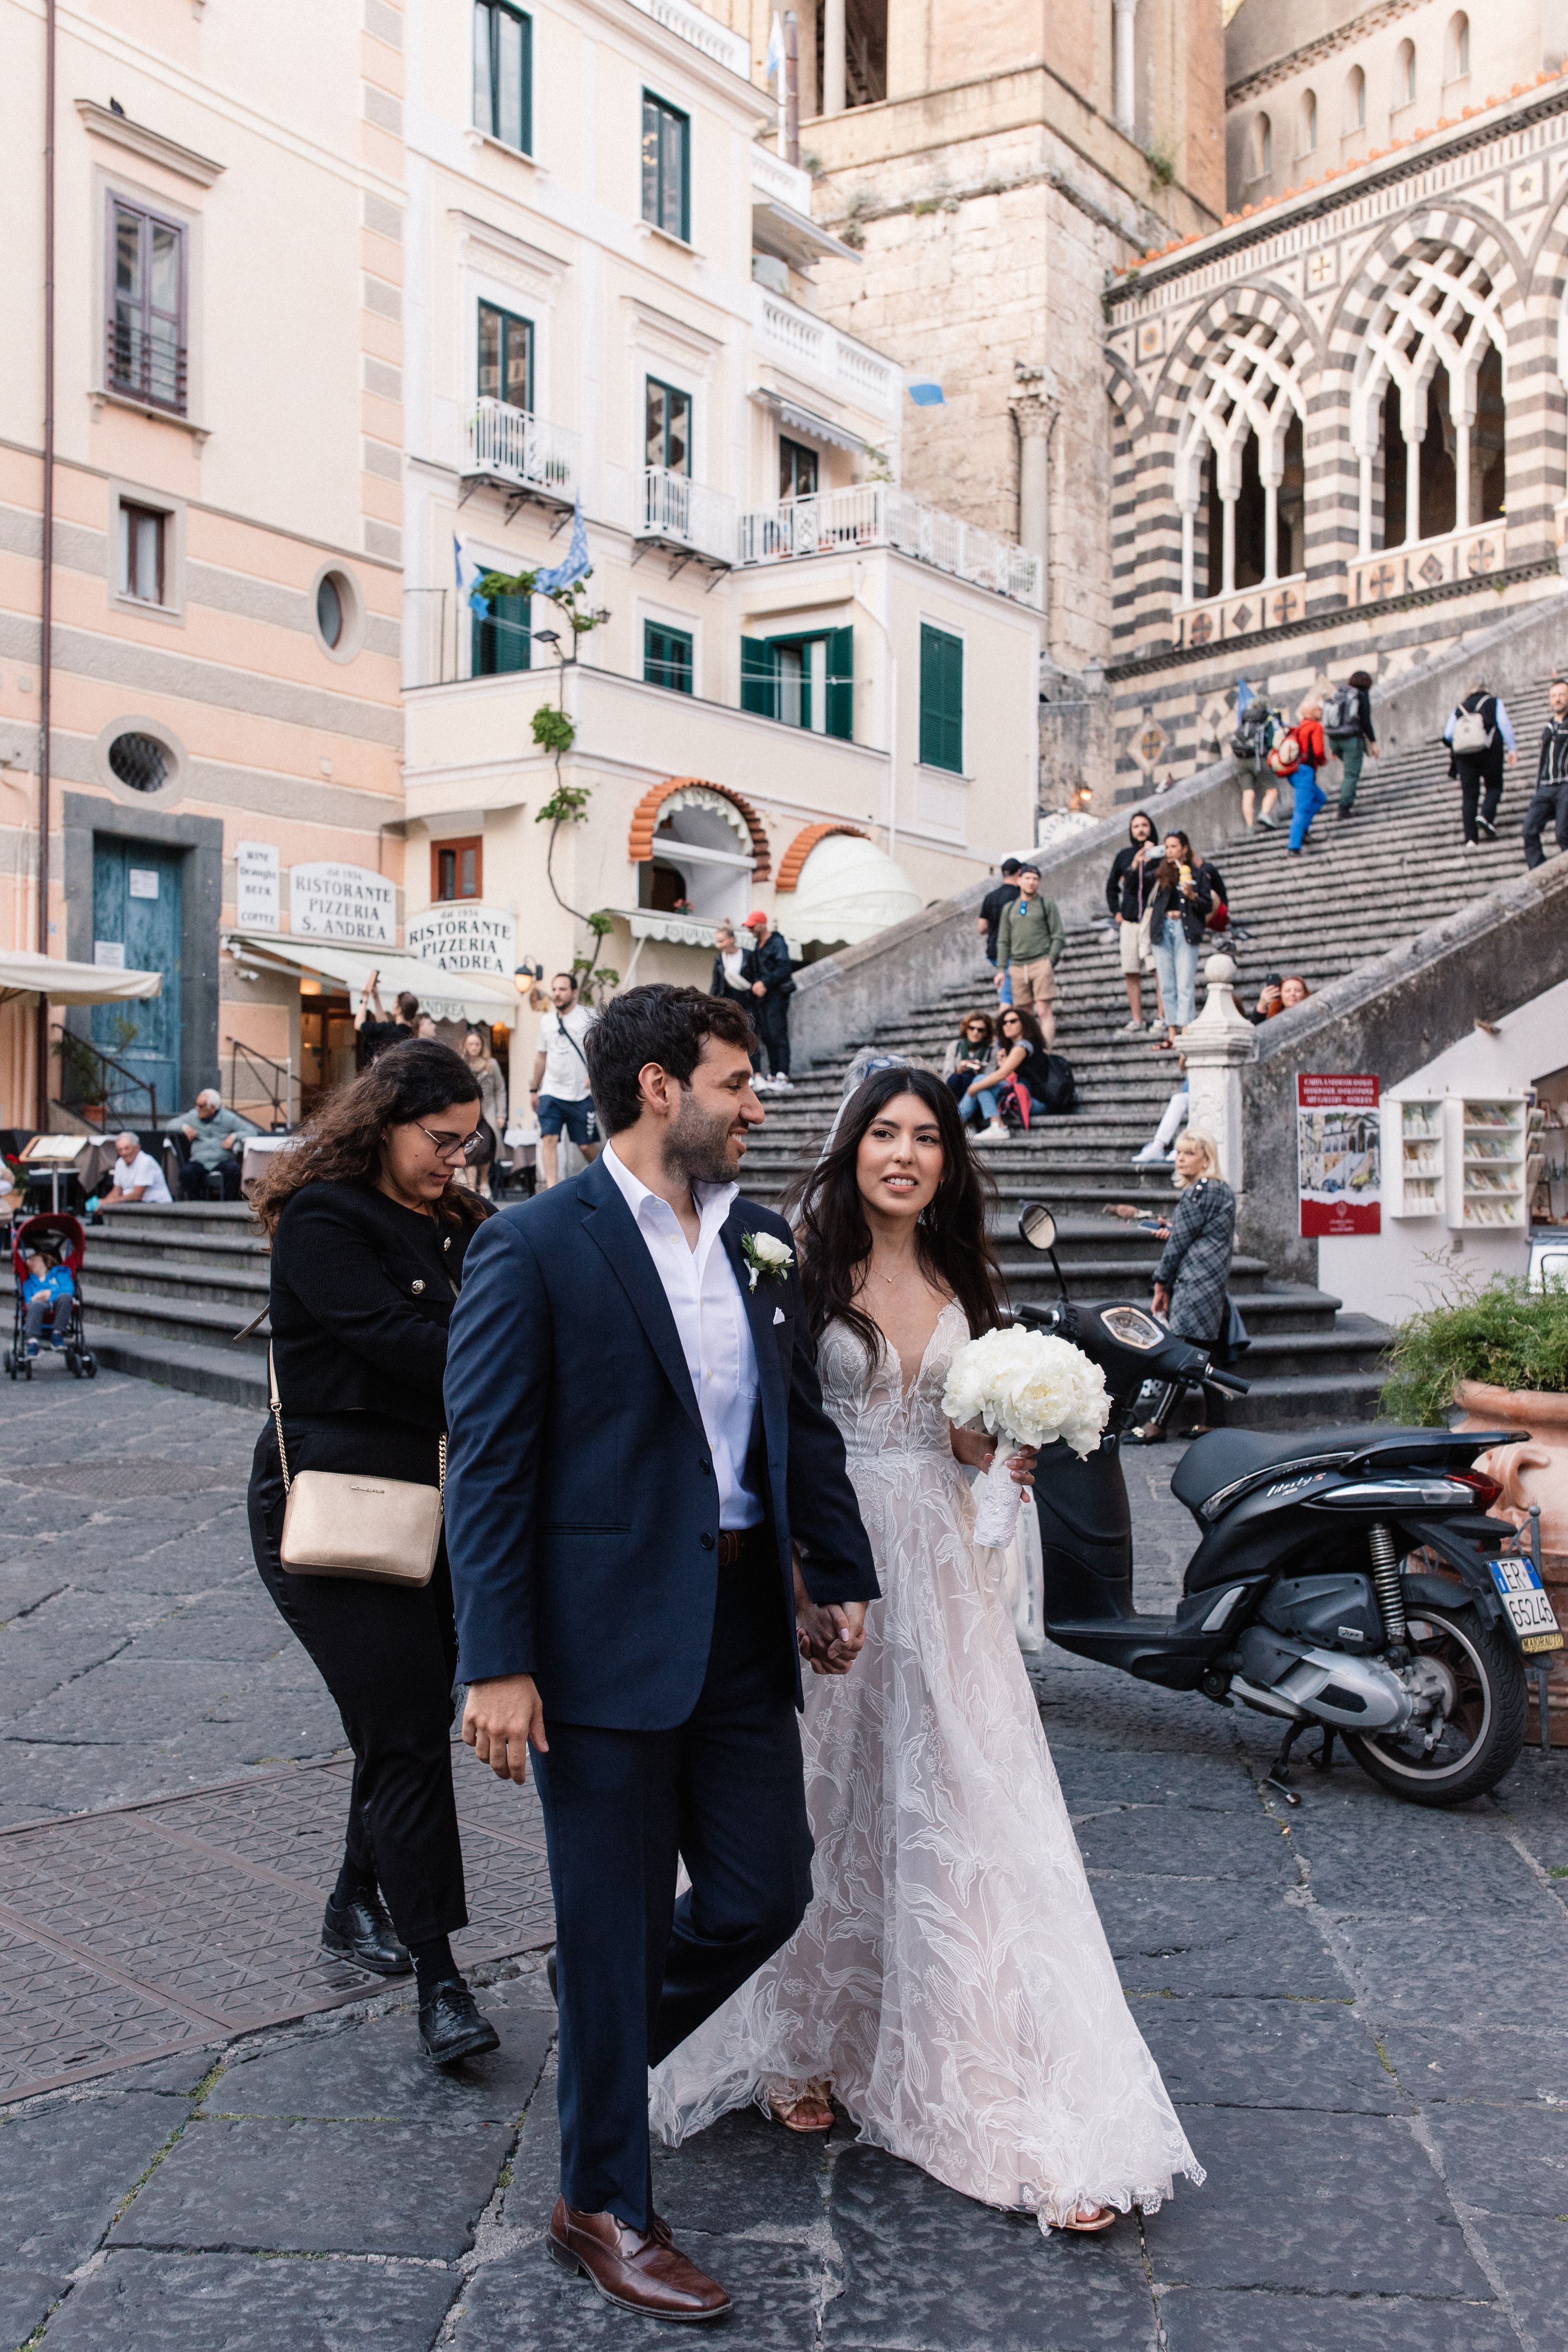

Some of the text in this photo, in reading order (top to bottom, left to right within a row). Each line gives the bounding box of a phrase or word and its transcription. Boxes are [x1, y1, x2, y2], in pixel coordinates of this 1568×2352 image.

[245, 885, 271, 895] BEER
[296, 876, 391, 903] RISTORANTE
[309, 898, 379, 920] PIZZERIA
[302, 916, 386, 940] S. ANDREA
[409, 920, 511, 946] RISTORANTE
[422, 938, 497, 958] PIZZERIA
[438, 955, 503, 972] ANDREA
[420, 1000, 465, 1016] ANDREA
[1501, 1563, 1526, 1589] ER
[1508, 1597, 1553, 1627] 65246
[1523, 1634, 1562, 1651] MAJORAUTO
